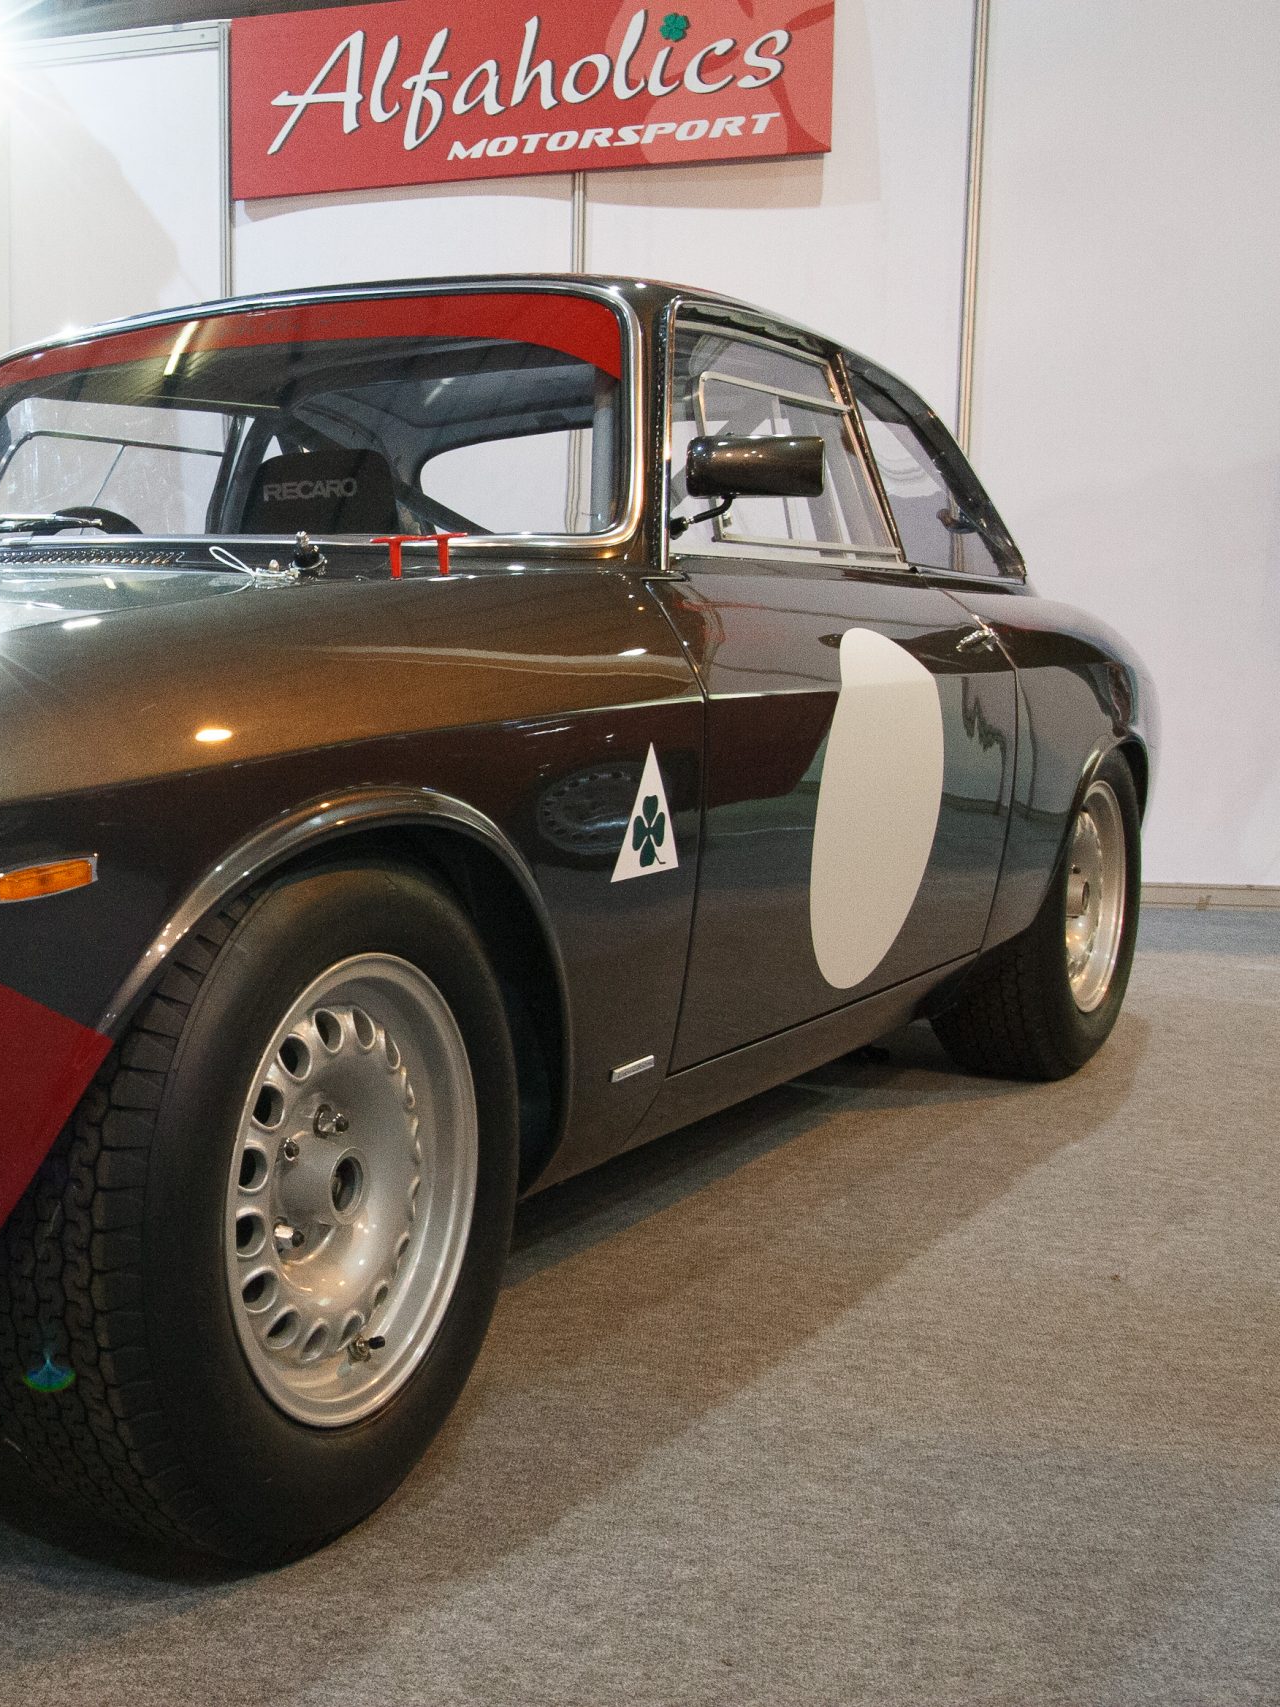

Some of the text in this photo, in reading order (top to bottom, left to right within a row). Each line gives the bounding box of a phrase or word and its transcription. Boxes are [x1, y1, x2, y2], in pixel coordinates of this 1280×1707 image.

[267, 9, 791, 156] Alfaholics
[446, 112, 781, 161] MOTORSPORT
[262, 477, 359, 502] RECARO
